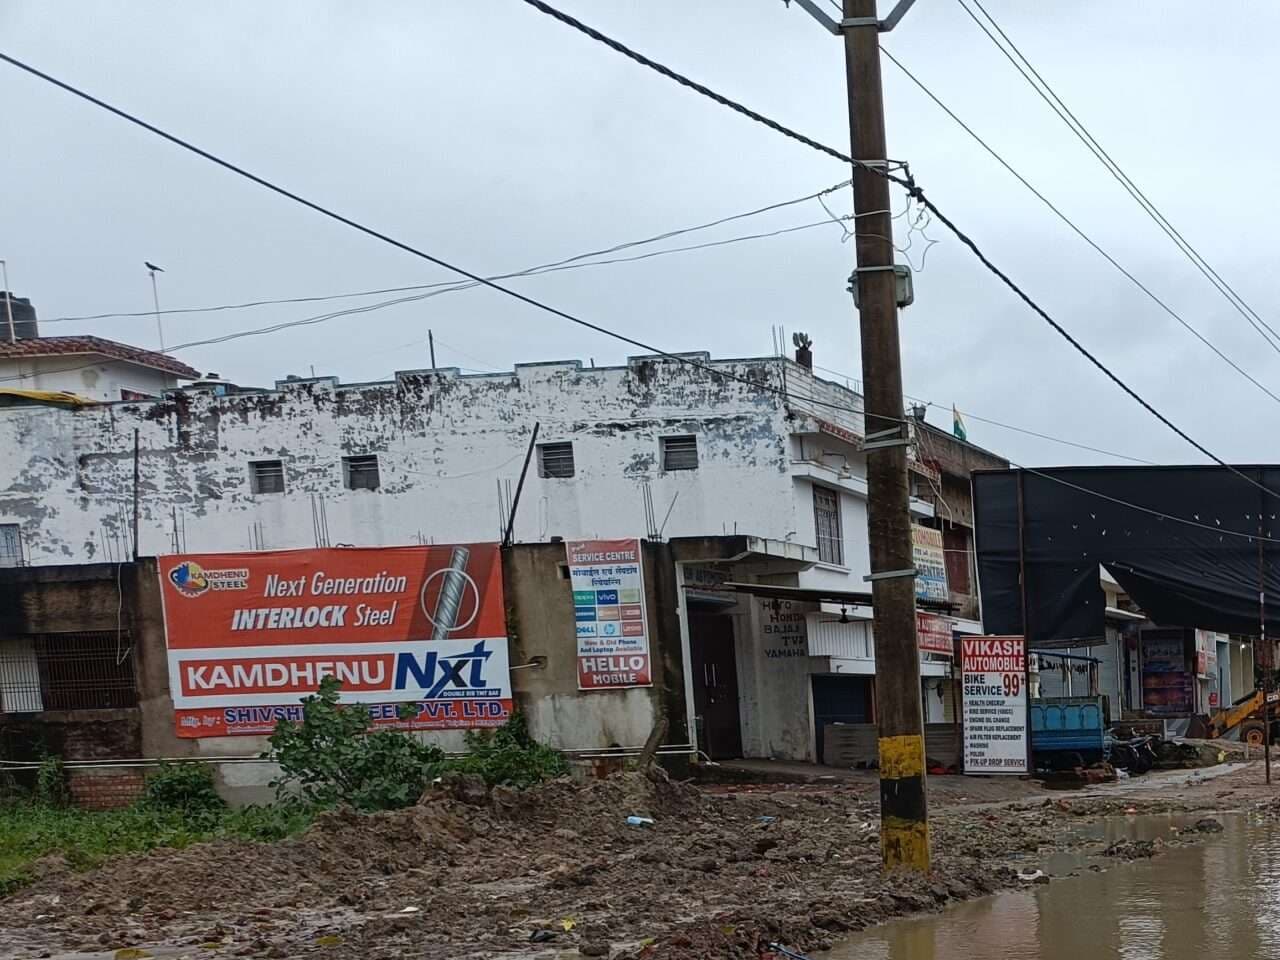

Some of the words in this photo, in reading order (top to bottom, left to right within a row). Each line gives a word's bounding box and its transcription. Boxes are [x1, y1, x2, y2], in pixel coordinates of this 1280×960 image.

[573, 552, 605, 562] SERVICE
[606, 551, 636, 561] CENTRE
[191, 569, 247, 580] KAMDHENU
[213, 581, 247, 589] STEEL
[264, 574, 306, 597] Next
[311, 571, 406, 596] Generation
[231, 604, 348, 631] INTERLOCK
[353, 600, 398, 627] Steel
[963, 640, 1024, 656] VIKASH
[187, 660, 385, 690] KAMDHENU
[395, 640, 494, 699] Nxt
[581, 657, 644, 673] HELLO
[964, 657, 1025, 671] AUTOMOBILE
[593, 673, 637, 685] MOBILE
[964, 674, 985, 684] BIKE
[964, 685, 1002, 696] SERVICE
[463, 700, 508, 717] LTD.
